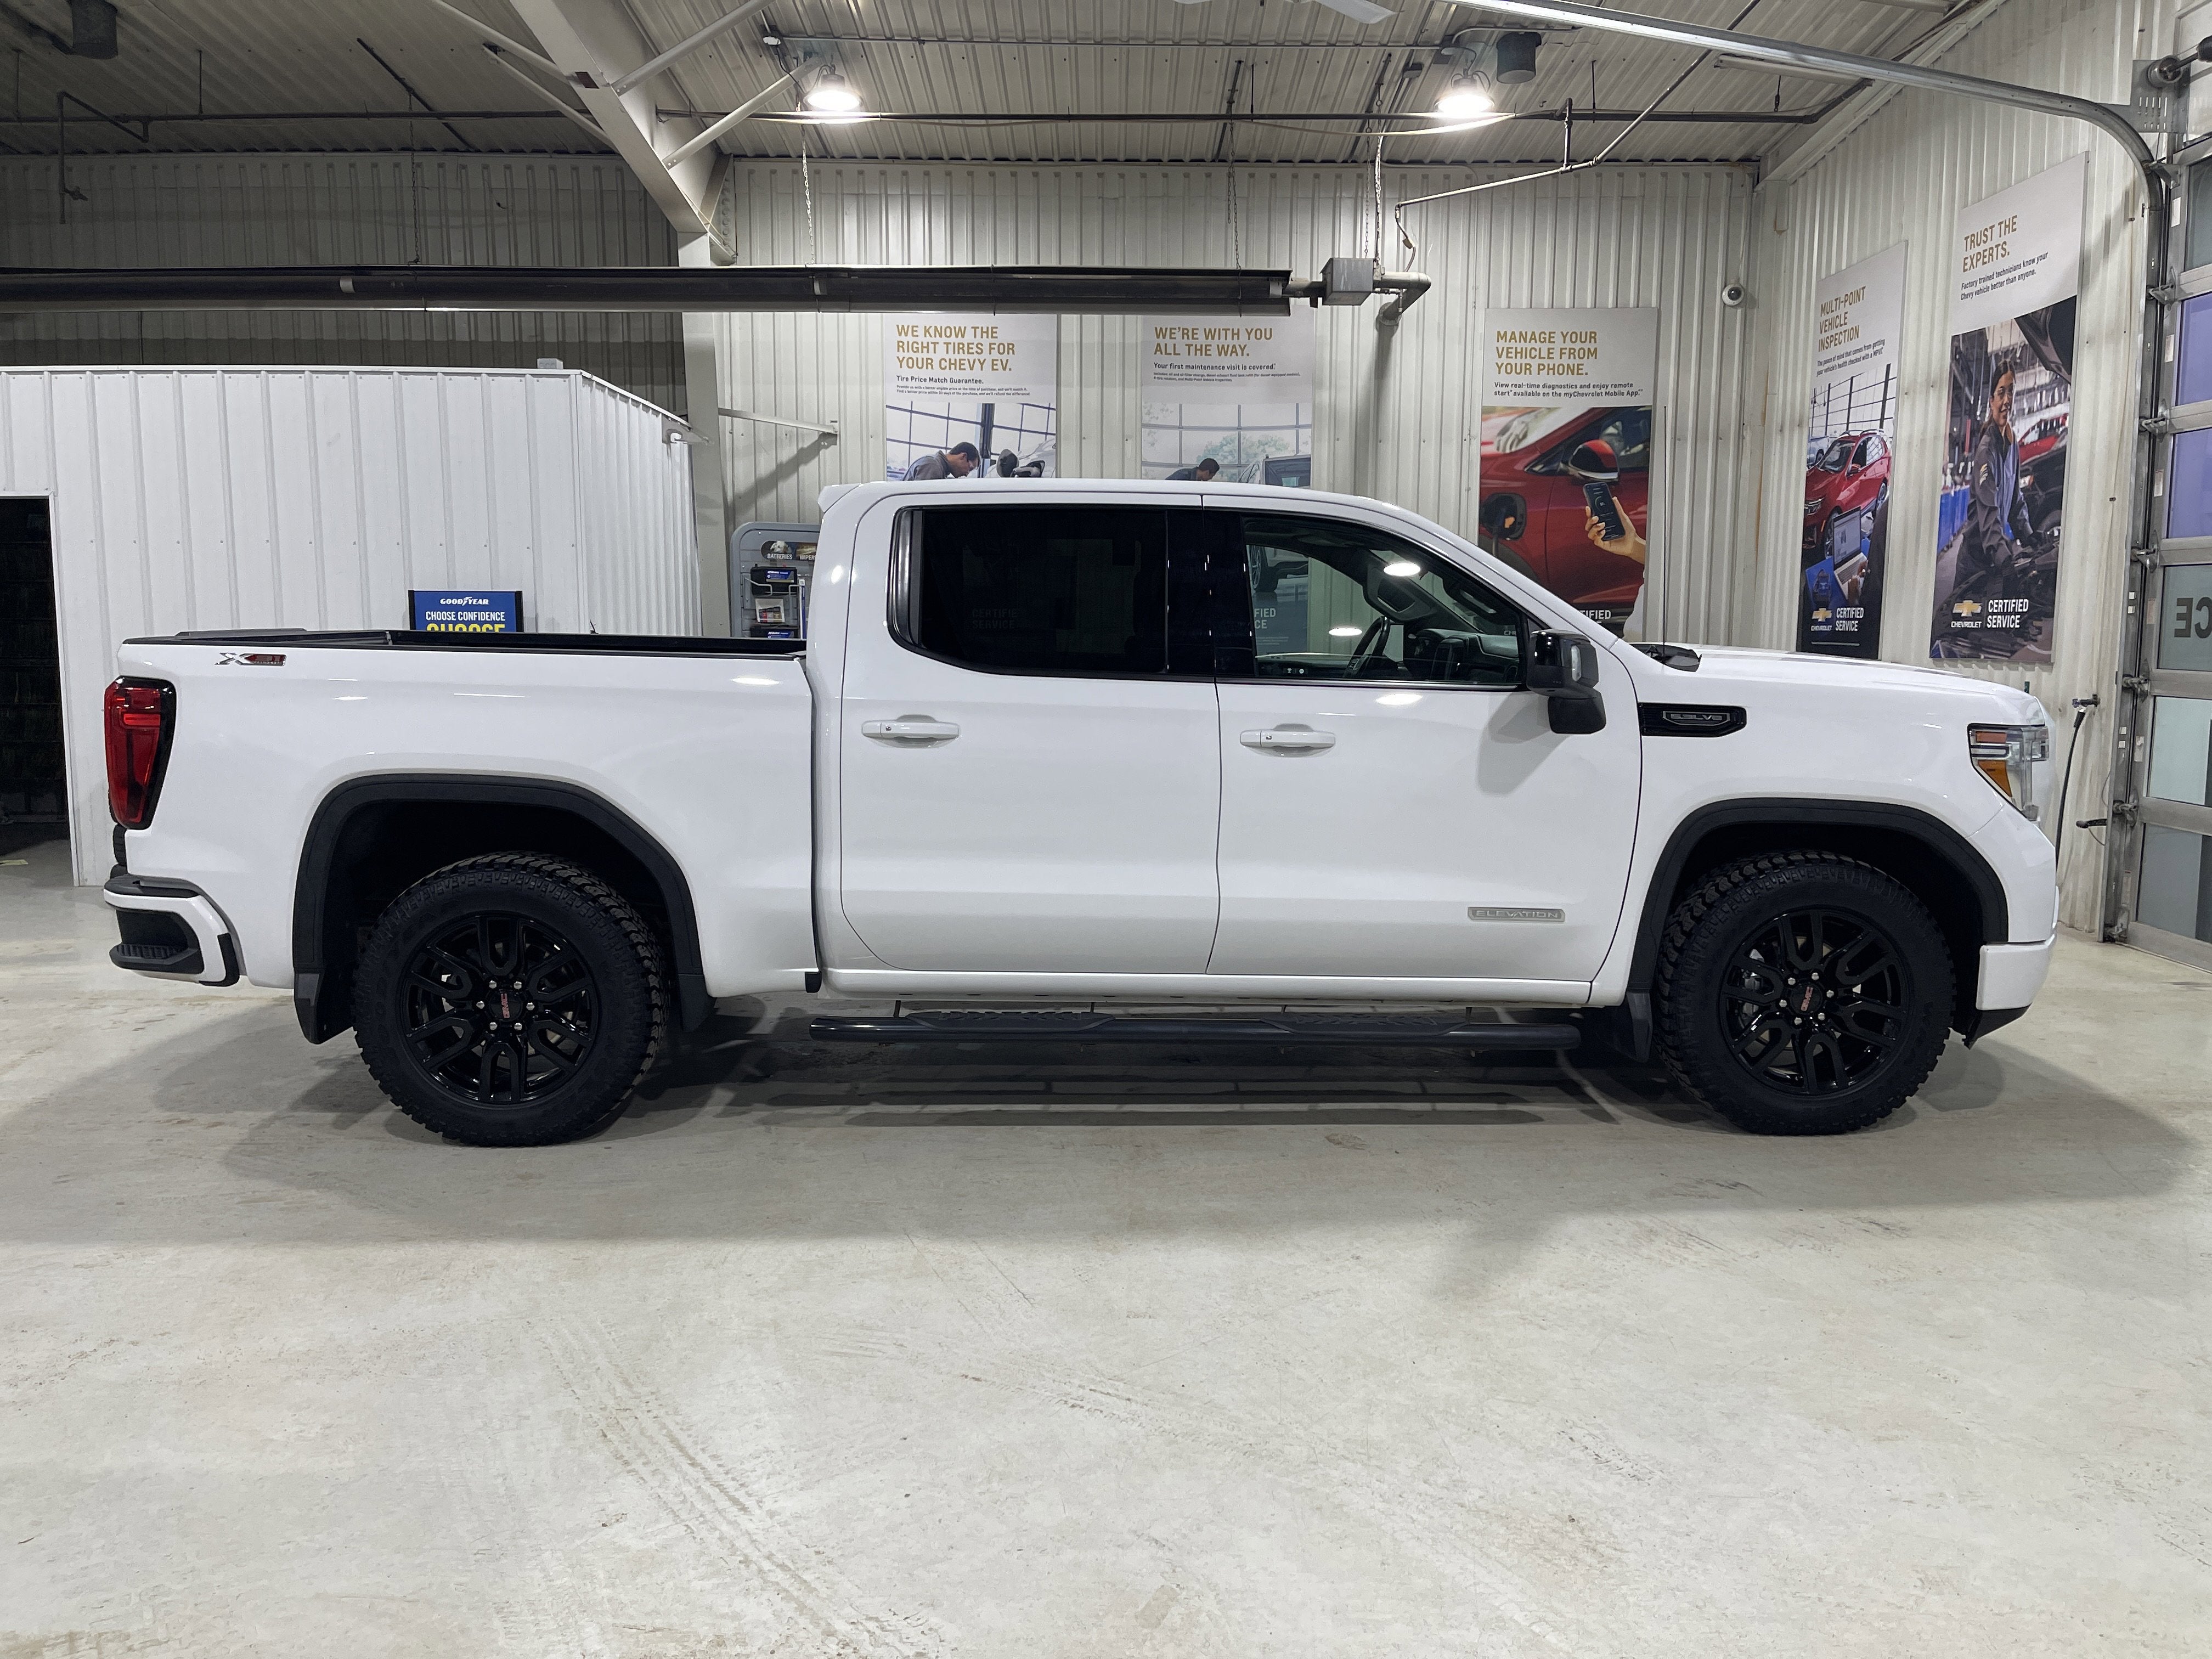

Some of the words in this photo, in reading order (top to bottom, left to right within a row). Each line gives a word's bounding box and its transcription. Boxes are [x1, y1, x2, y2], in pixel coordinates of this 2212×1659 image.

[1964, 224, 1995, 252] TRUST
[1998, 215, 2017, 238] THE
[1963, 241, 2010, 273] EXPERTS.
[1961, 279, 1978, 290] Factory
[1979, 272, 1994, 284] trained
[1996, 263, 2022, 278] technicians
[2023, 257, 2035, 268] know
[2036, 252, 2048, 264] your
[1961, 290, 1973, 300] Chevy
[1974, 285, 1990, 296] vehicle
[1991, 280, 2005, 290] better
[2006, 275, 2016, 285] than
[2018, 269, 2036, 280] anyone.
[1821, 286, 1866, 317] MULTI-POINT
[1820, 312, 1848, 334] VEHICLE
[896, 325, 918, 337] WE
[924, 326, 966, 338] KNOW
[972, 327, 998, 338] THE
[1154, 327, 1199, 340] WE'RE
[1204, 328, 1240, 340] WITH
[1245, 328, 1273, 340] YOU
[1497, 331, 1555, 343] MANAGE
[1560, 331, 1597, 343] YOUR
[1819, 325, 1859, 352] INSPECTION
[896, 341, 939, 354] RIGHT
[944, 342, 983, 355] TIRES
[989, 343, 1015, 355] FOR
[1154, 343, 1180, 356] ALL
[1185, 344, 1211, 356] THE
[1217, 345, 1250, 357] WAY.
[1496, 347, 1555, 359] VEHICLE
[1560, 348, 1598, 359] FROM
[896, 357, 934, 369] YOUR
[939, 358, 986, 370] CHEVY
[991, 359, 1012, 371] EV.
[1496, 363, 1532, 375] YOUR
[1538, 364, 1588, 376] PHONE.
[440, 597, 489, 606] GOODYEAR
[1988, 599, 2029, 612] CERTIFIED
[426, 611, 456, 620] CHOOSE
[458, 612, 505, 621] CONFIDENCE
[1836, 608, 1864, 618] CERTIFIED
[1836, 620, 1858, 631] SERVICE
[1987, 615, 2021, 628] SERVICE
[1801, 986, 1813, 1011] GMC
[501, 994, 510, 1018] GMC
